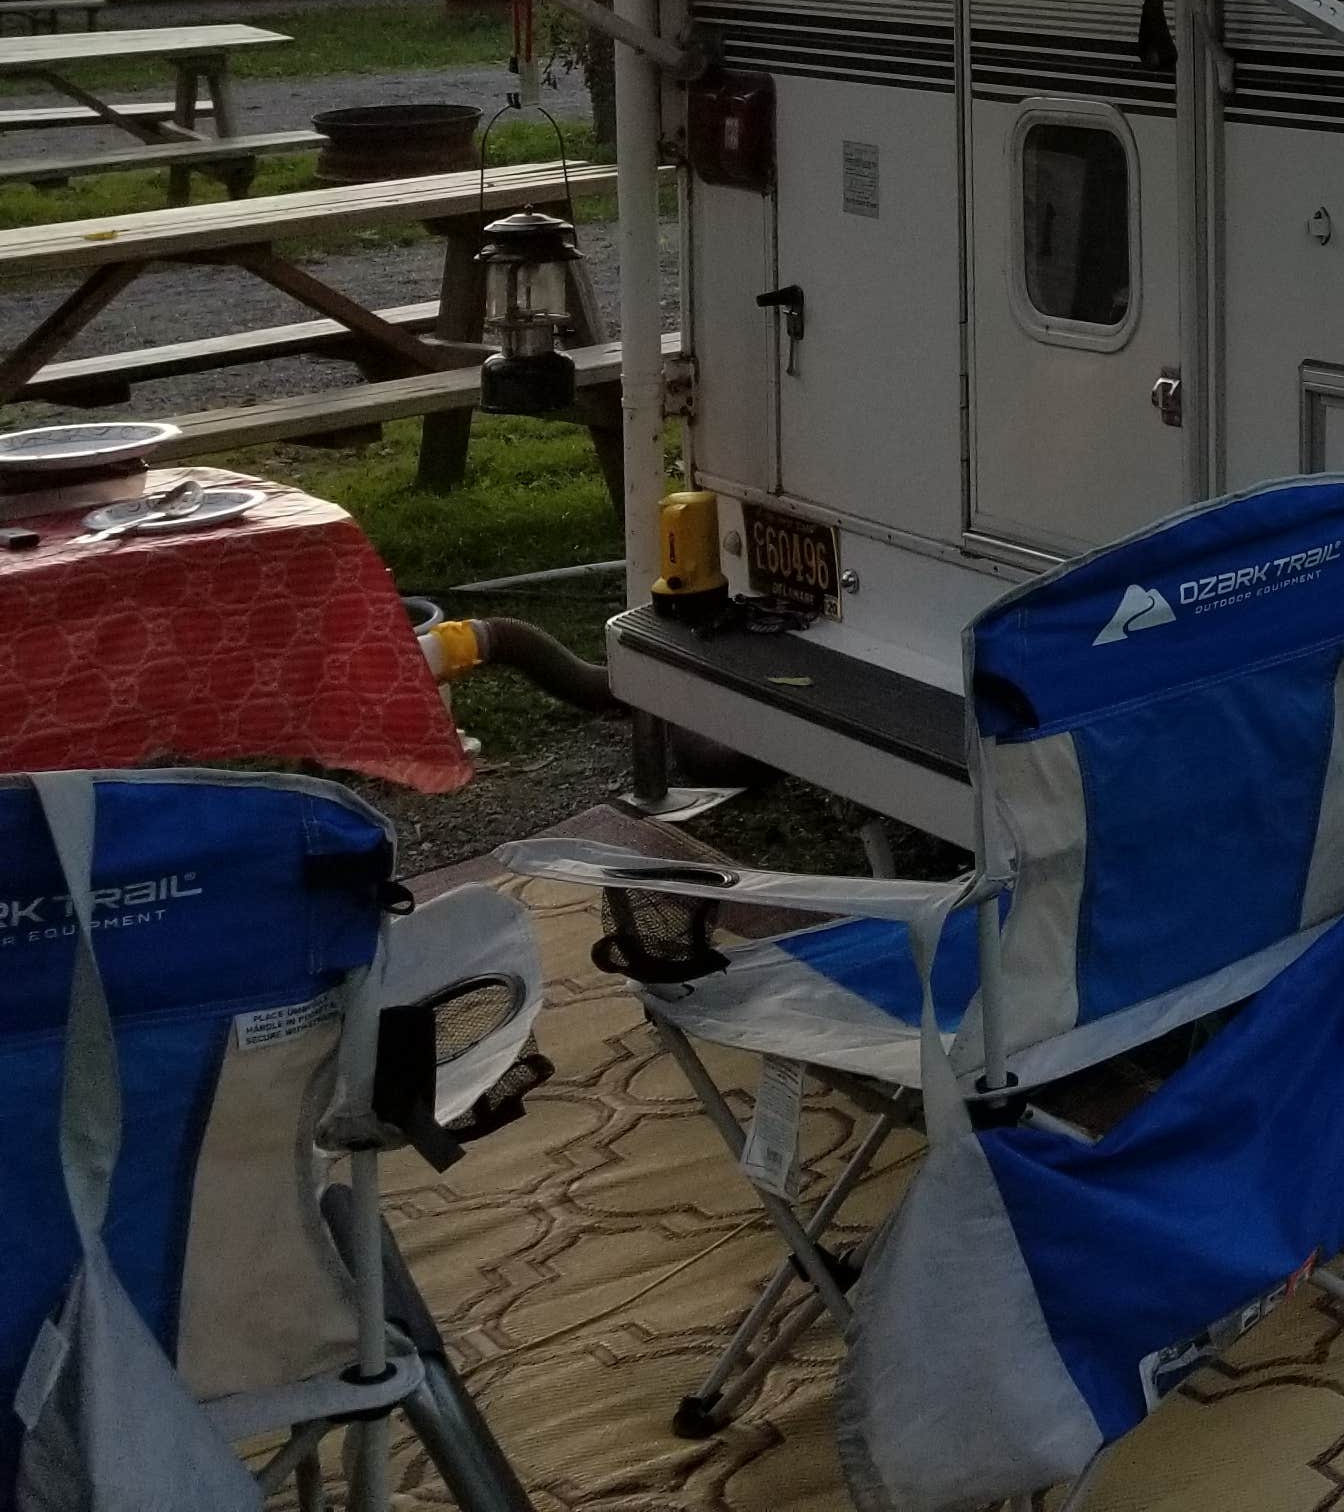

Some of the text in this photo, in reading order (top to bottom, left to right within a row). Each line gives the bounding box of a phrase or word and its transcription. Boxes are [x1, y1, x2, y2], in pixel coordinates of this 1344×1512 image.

[1179, 543, 1342, 606] OZARK TRAIL
[1194, 569, 1323, 615] OUTDOOR EQUIPMENT
[28, 908, 168, 944] EQUPMENT
